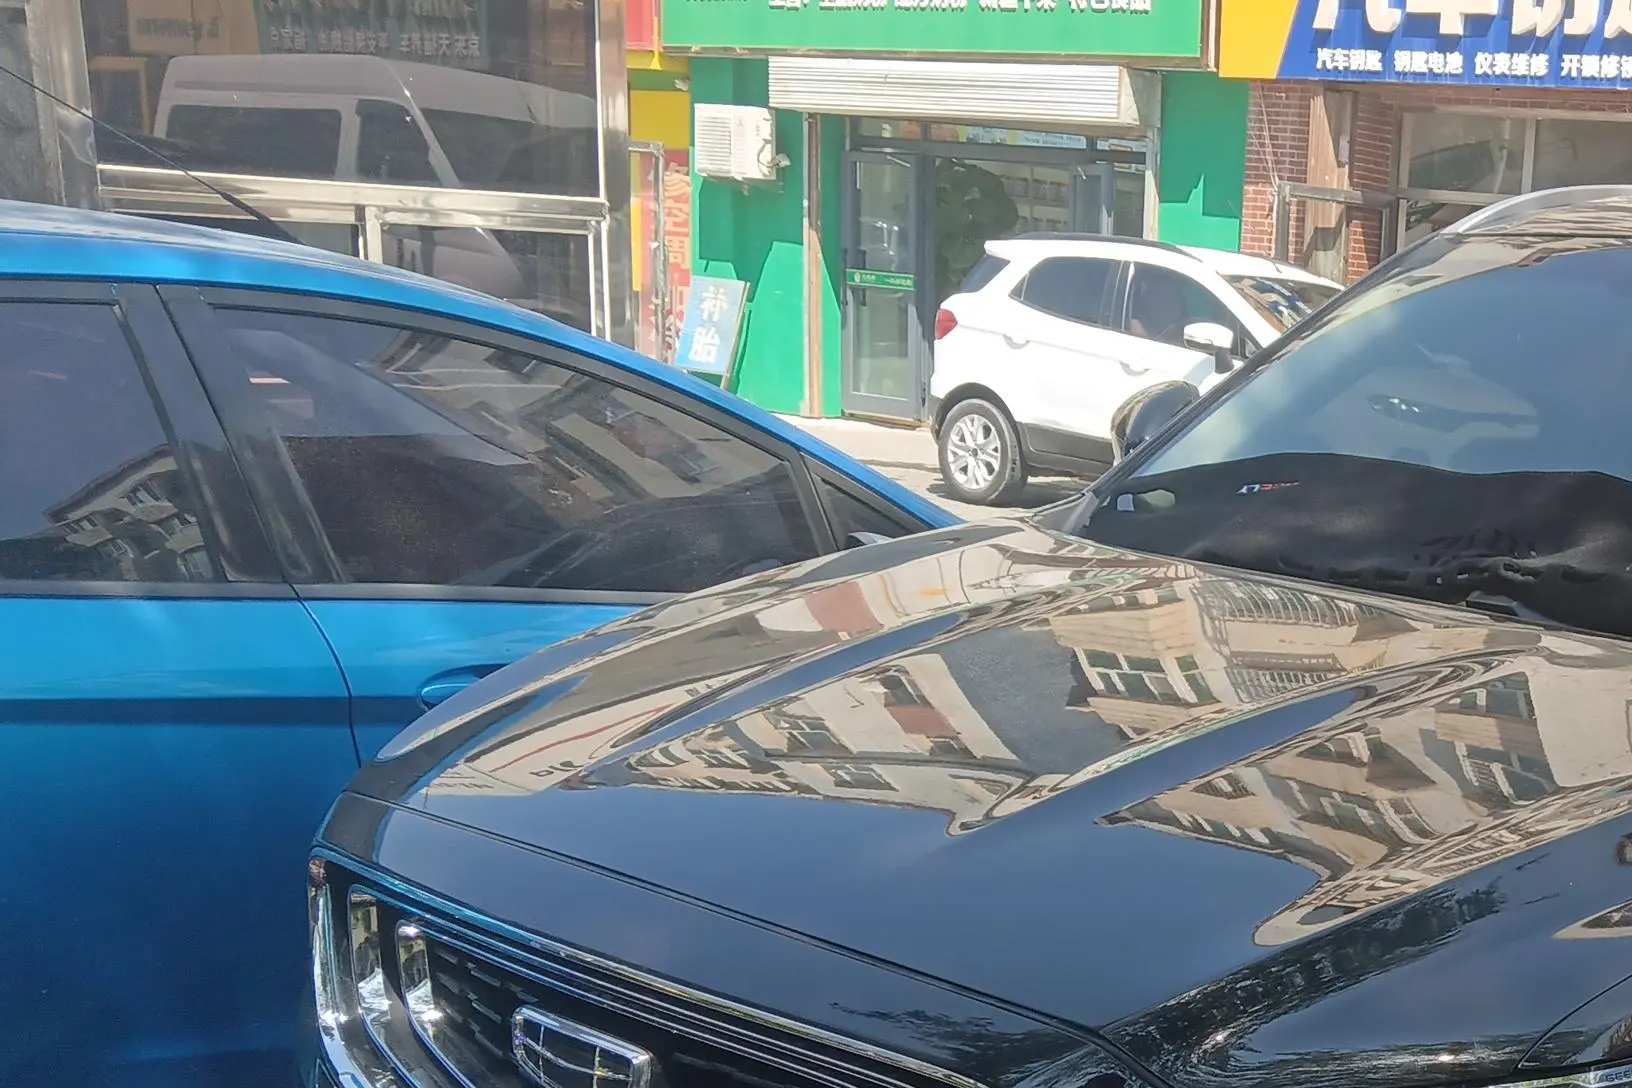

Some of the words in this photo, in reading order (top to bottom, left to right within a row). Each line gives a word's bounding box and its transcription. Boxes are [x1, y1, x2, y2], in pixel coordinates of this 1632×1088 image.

[1316, 48, 1384, 72] 汽车钥匙
[1394, 50, 1464, 75] 钥匙电池
[1475, 52, 1550, 77] 仪表维修
[687, 285, 729, 365] 补胎
